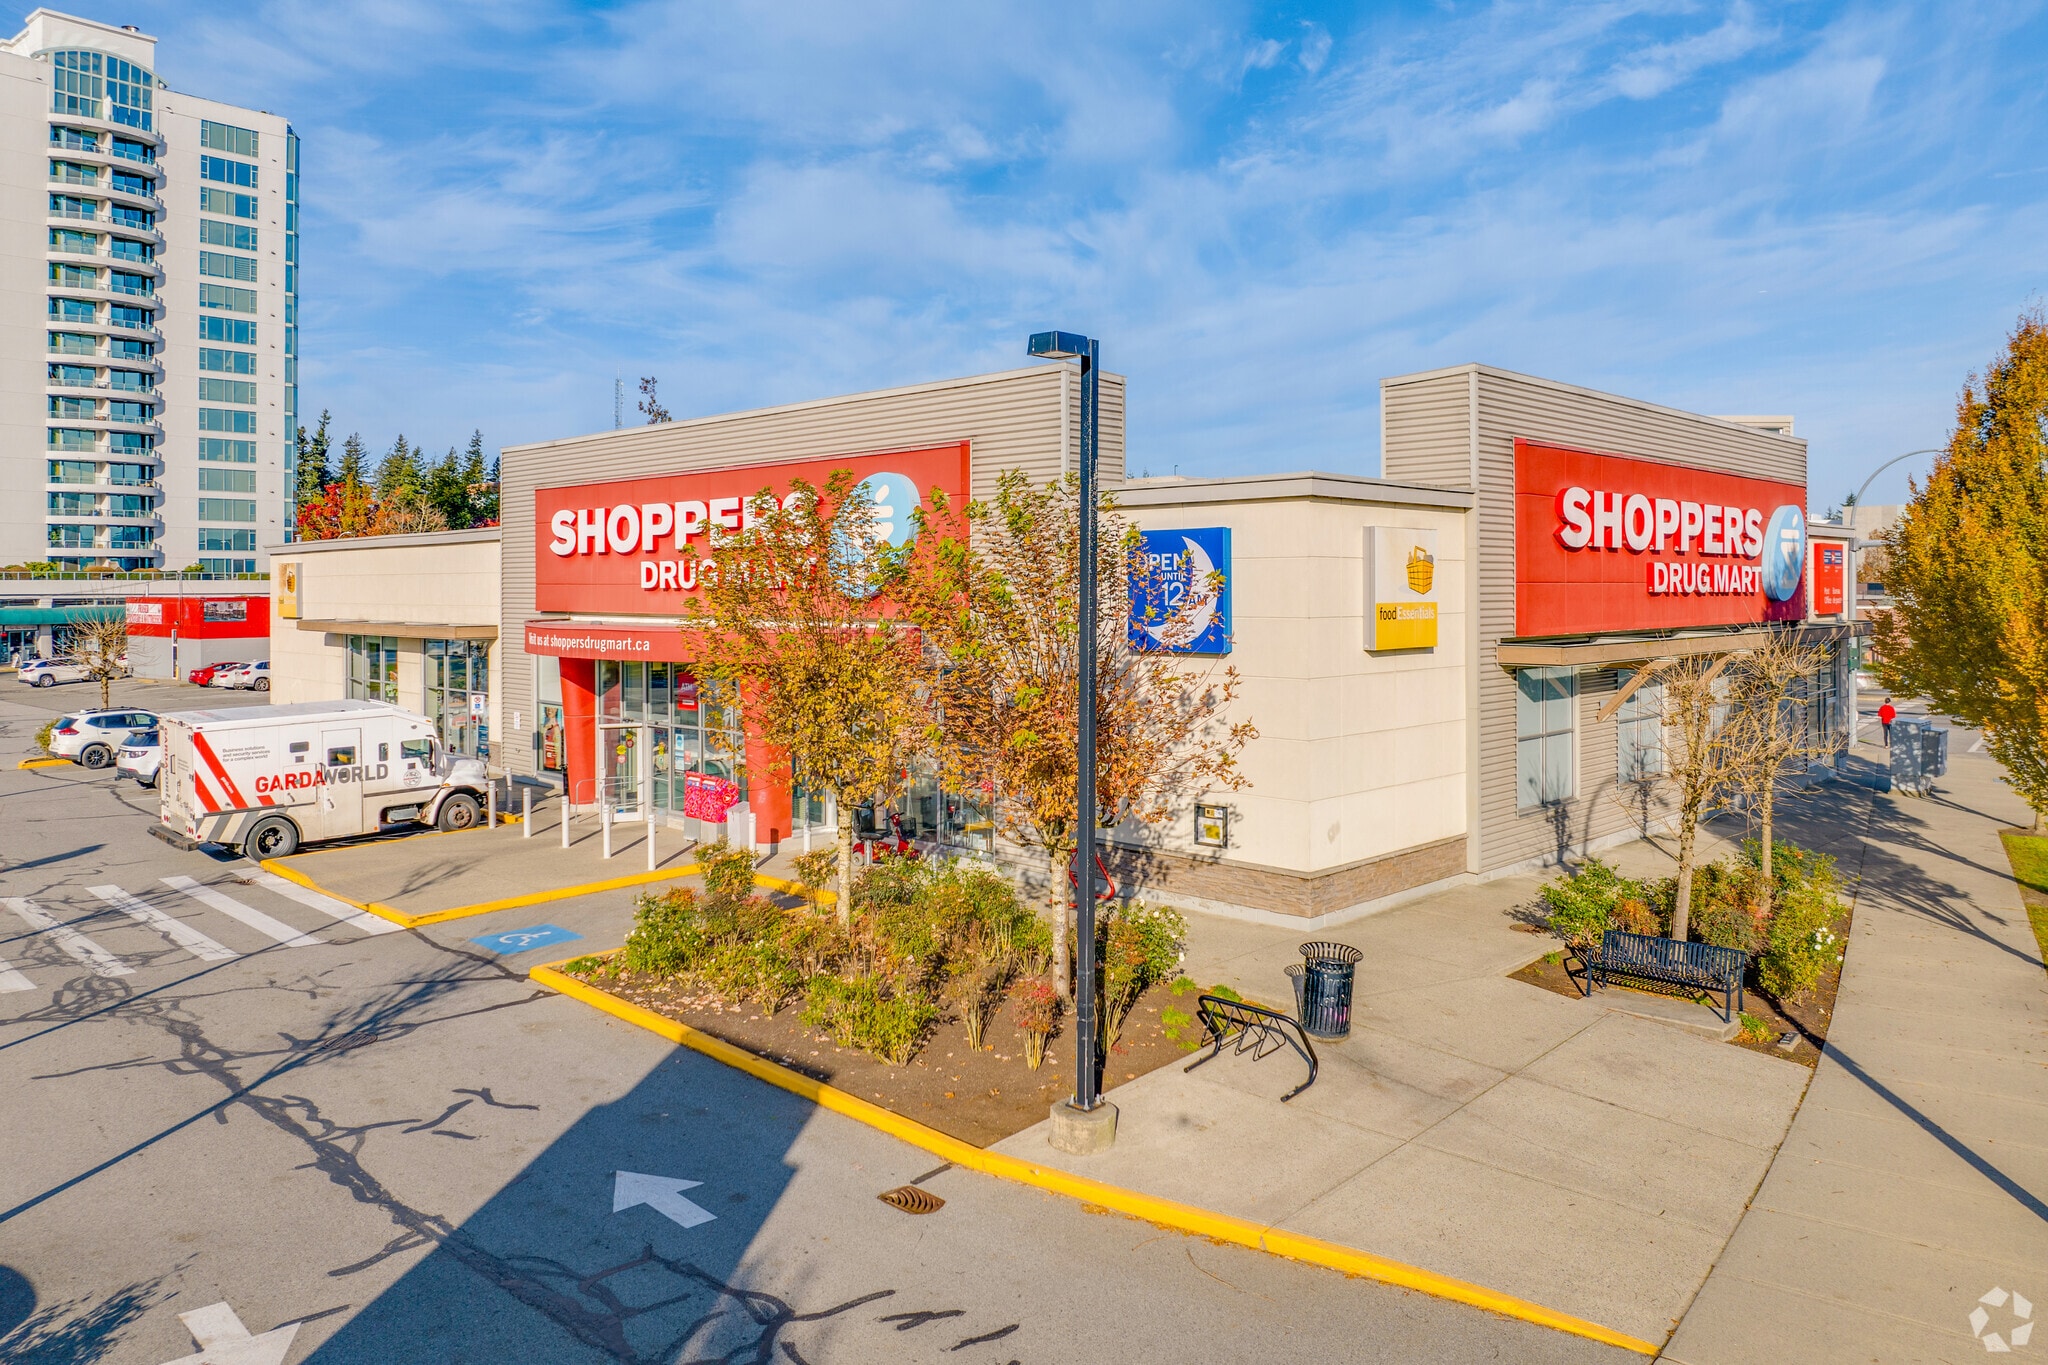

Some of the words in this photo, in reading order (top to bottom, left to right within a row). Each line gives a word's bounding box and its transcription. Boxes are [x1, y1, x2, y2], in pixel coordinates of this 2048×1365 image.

[1560, 486, 1763, 557] SHOPPERS
[1161, 572, 1186, 581] UNTIL
[1653, 561, 1710, 593] DRUG
[1713, 563, 1763, 593] MART
[1162, 582, 1184, 606] 12
[543, 634, 550, 646] at
[550, 634, 650, 653] shoppersdrugmart.ca
[255, 764, 389, 793] GARDAWORLD
